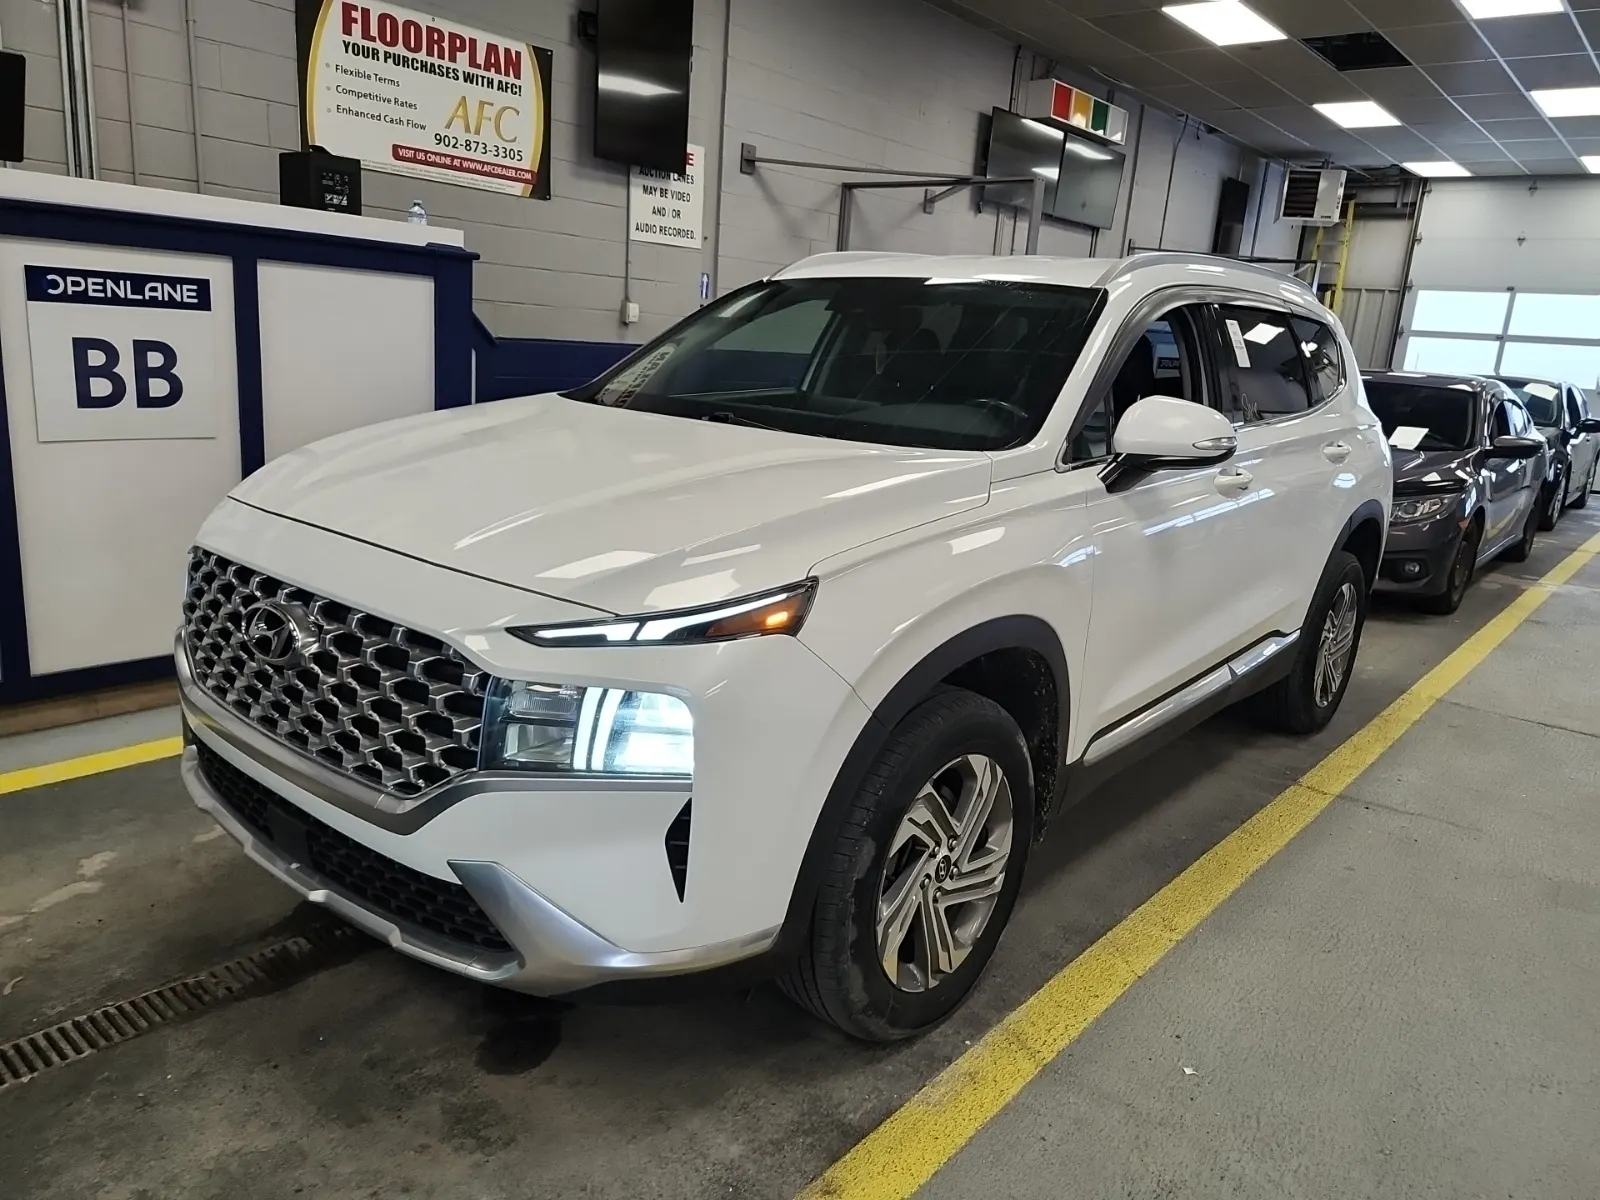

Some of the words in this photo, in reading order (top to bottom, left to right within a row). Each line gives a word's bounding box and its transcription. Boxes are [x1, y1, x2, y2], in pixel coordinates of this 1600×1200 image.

[341, 1, 522, 80] FLOORPLAN
[335, 64, 372, 81] Flexible
[373, 73, 401, 88] Terms
[342, 40, 380, 61] YOUR
[383, 50, 460, 81] PURCHASES
[462, 70, 494, 90] WITH
[496, 80, 522, 97] AFC!
[335, 85, 392, 105] Competitive
[393, 97, 418, 110] Rates
[336, 104, 382, 122] Enhanced
[383, 114, 405, 126] Cash
[406, 119, 427, 131] Flow
[444, 95, 520, 143] AFC
[434, 133, 523, 162] 902-873-3305
[397, 148, 415, 158] VISIT
[416, 152, 426, 160] US
[427, 154, 452, 165] ONLINE
[453, 159, 462, 167] AT
[462, 160, 532, 180] WWW.AFCDEALER.COM
[642, 184, 658, 196] MAY
[659, 188, 669, 198] BE
[670, 190, 691, 203] VIDEO
[651, 206, 667, 217] AND
[671, 209, 682, 219] OR
[635, 222, 657, 234] AUDIO
[659, 226, 697, 240] RECORDED.
[46, 274, 199, 303] OPENLANE
[72, 337, 184, 409] BB
